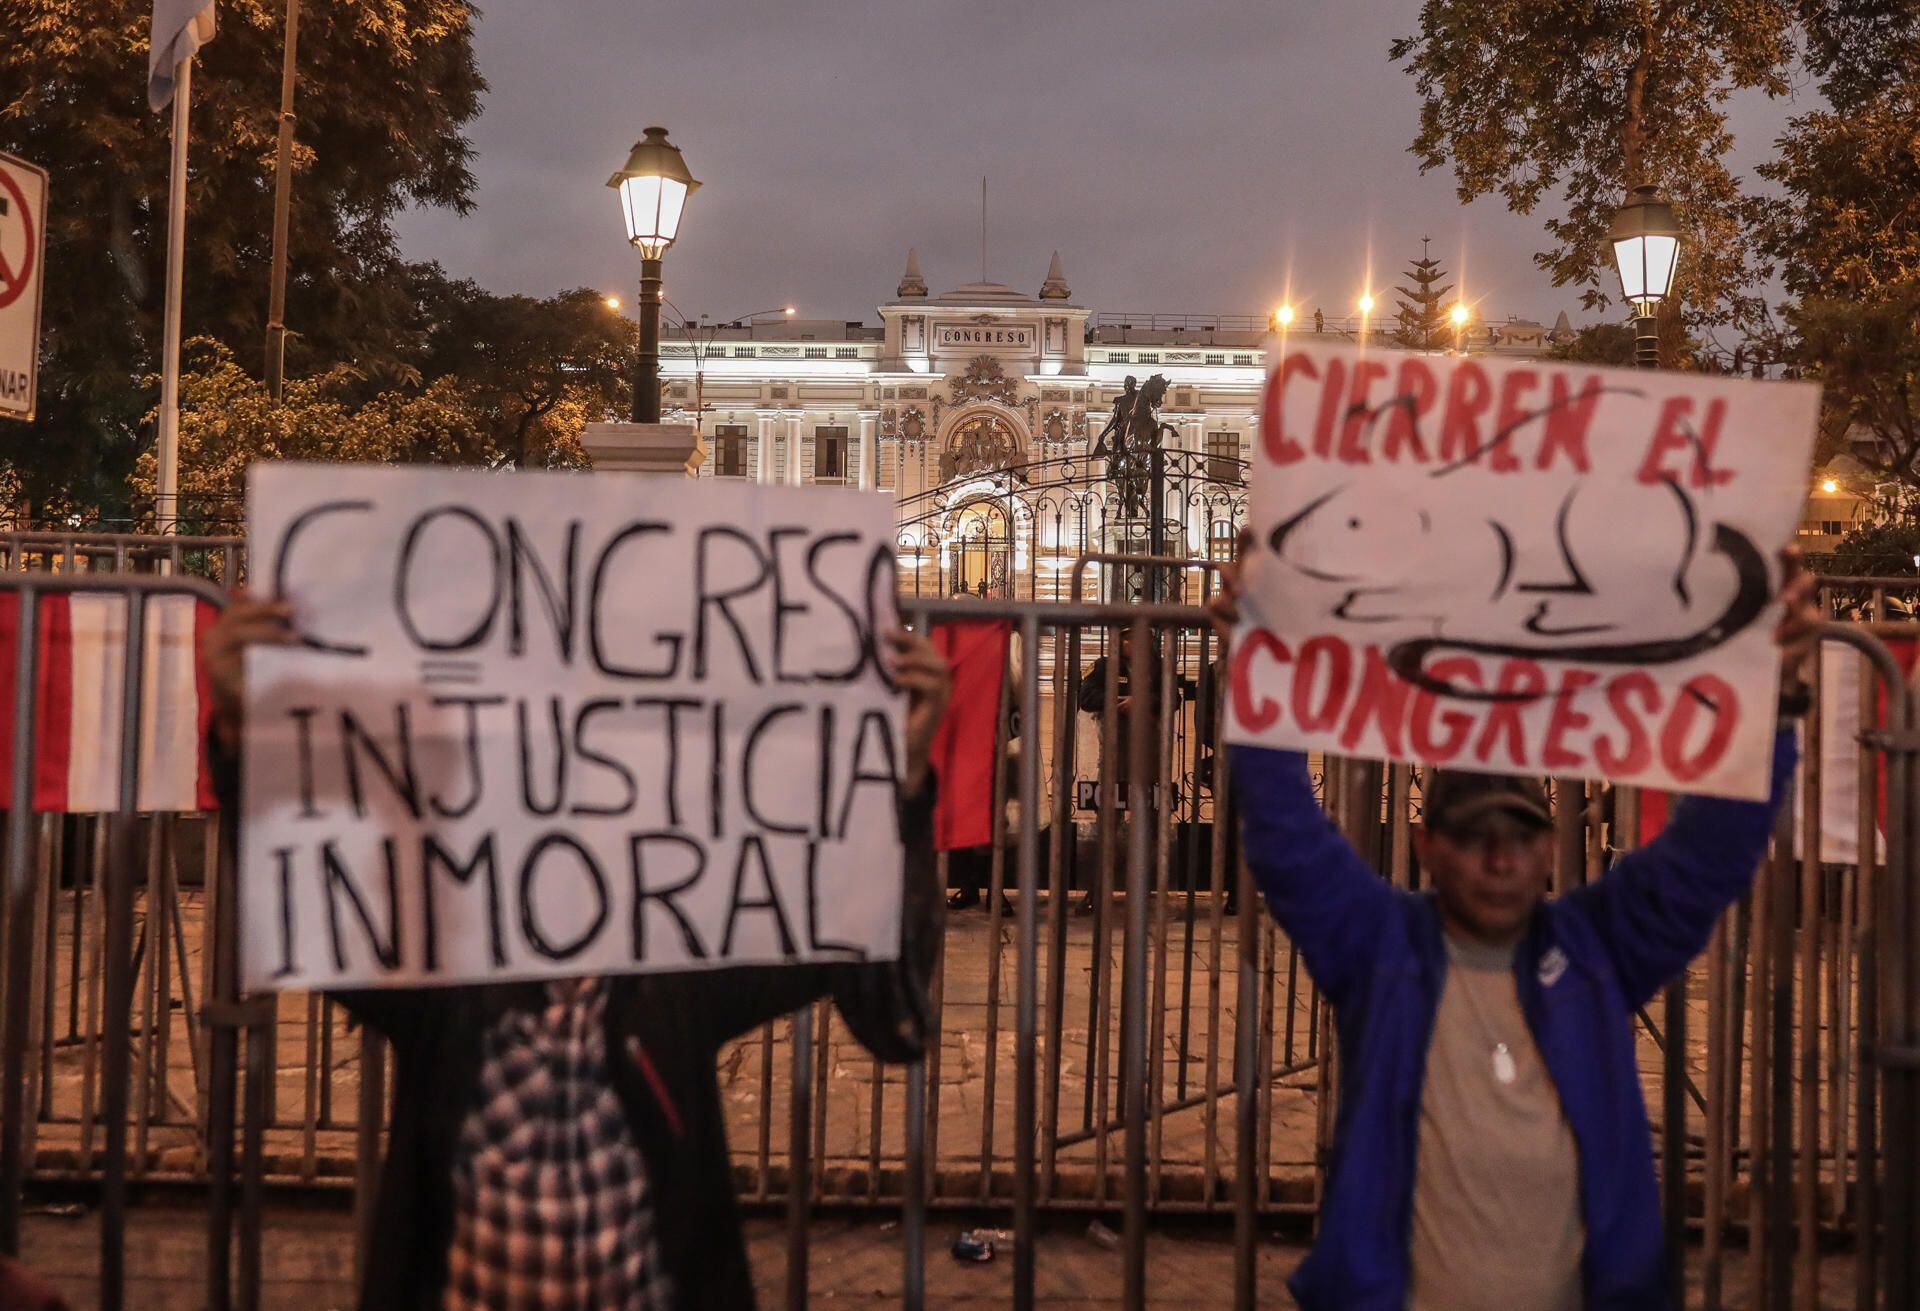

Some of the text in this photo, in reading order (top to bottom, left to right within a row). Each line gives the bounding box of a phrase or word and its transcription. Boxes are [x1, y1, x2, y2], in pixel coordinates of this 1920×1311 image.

[945, 330, 1025, 343] CONGRESO
[1261, 353, 1737, 488] CIERREN EL
[274, 499, 902, 694] CONGRESO
[287, 695, 905, 842] INJUSTICIA
[1228, 628, 1741, 783] CONGRESO
[271, 829, 867, 978] INMORAL
